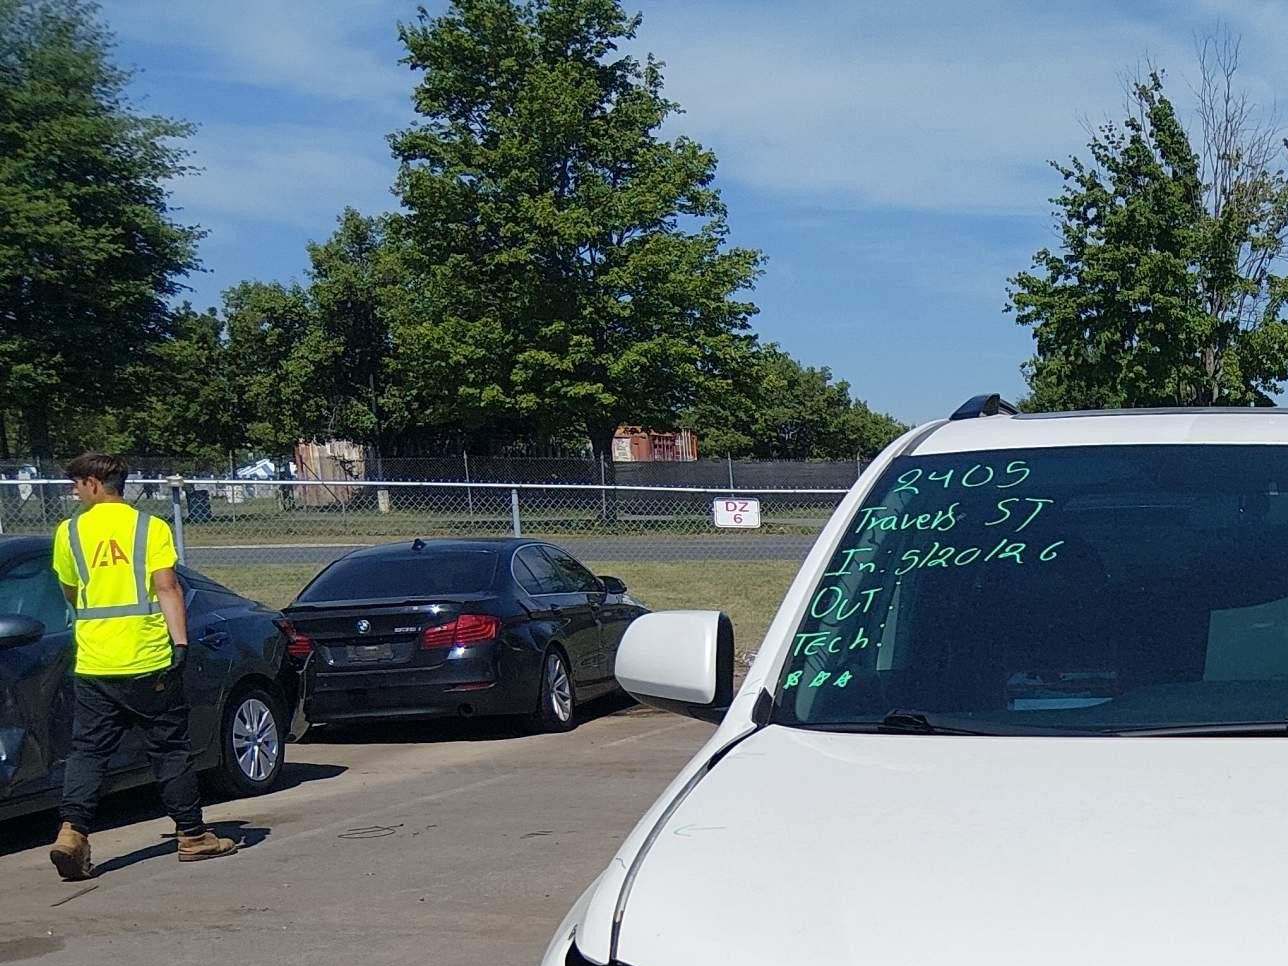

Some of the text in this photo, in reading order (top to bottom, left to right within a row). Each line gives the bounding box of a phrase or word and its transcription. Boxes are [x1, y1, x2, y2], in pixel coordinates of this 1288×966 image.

[894, 461, 1030, 494] 2405
[725, 501, 750, 512] DZ
[733, 513, 743, 524] 6
[985, 498, 1054, 532] ST
[895, 539, 1064, 575] 5/20/26
